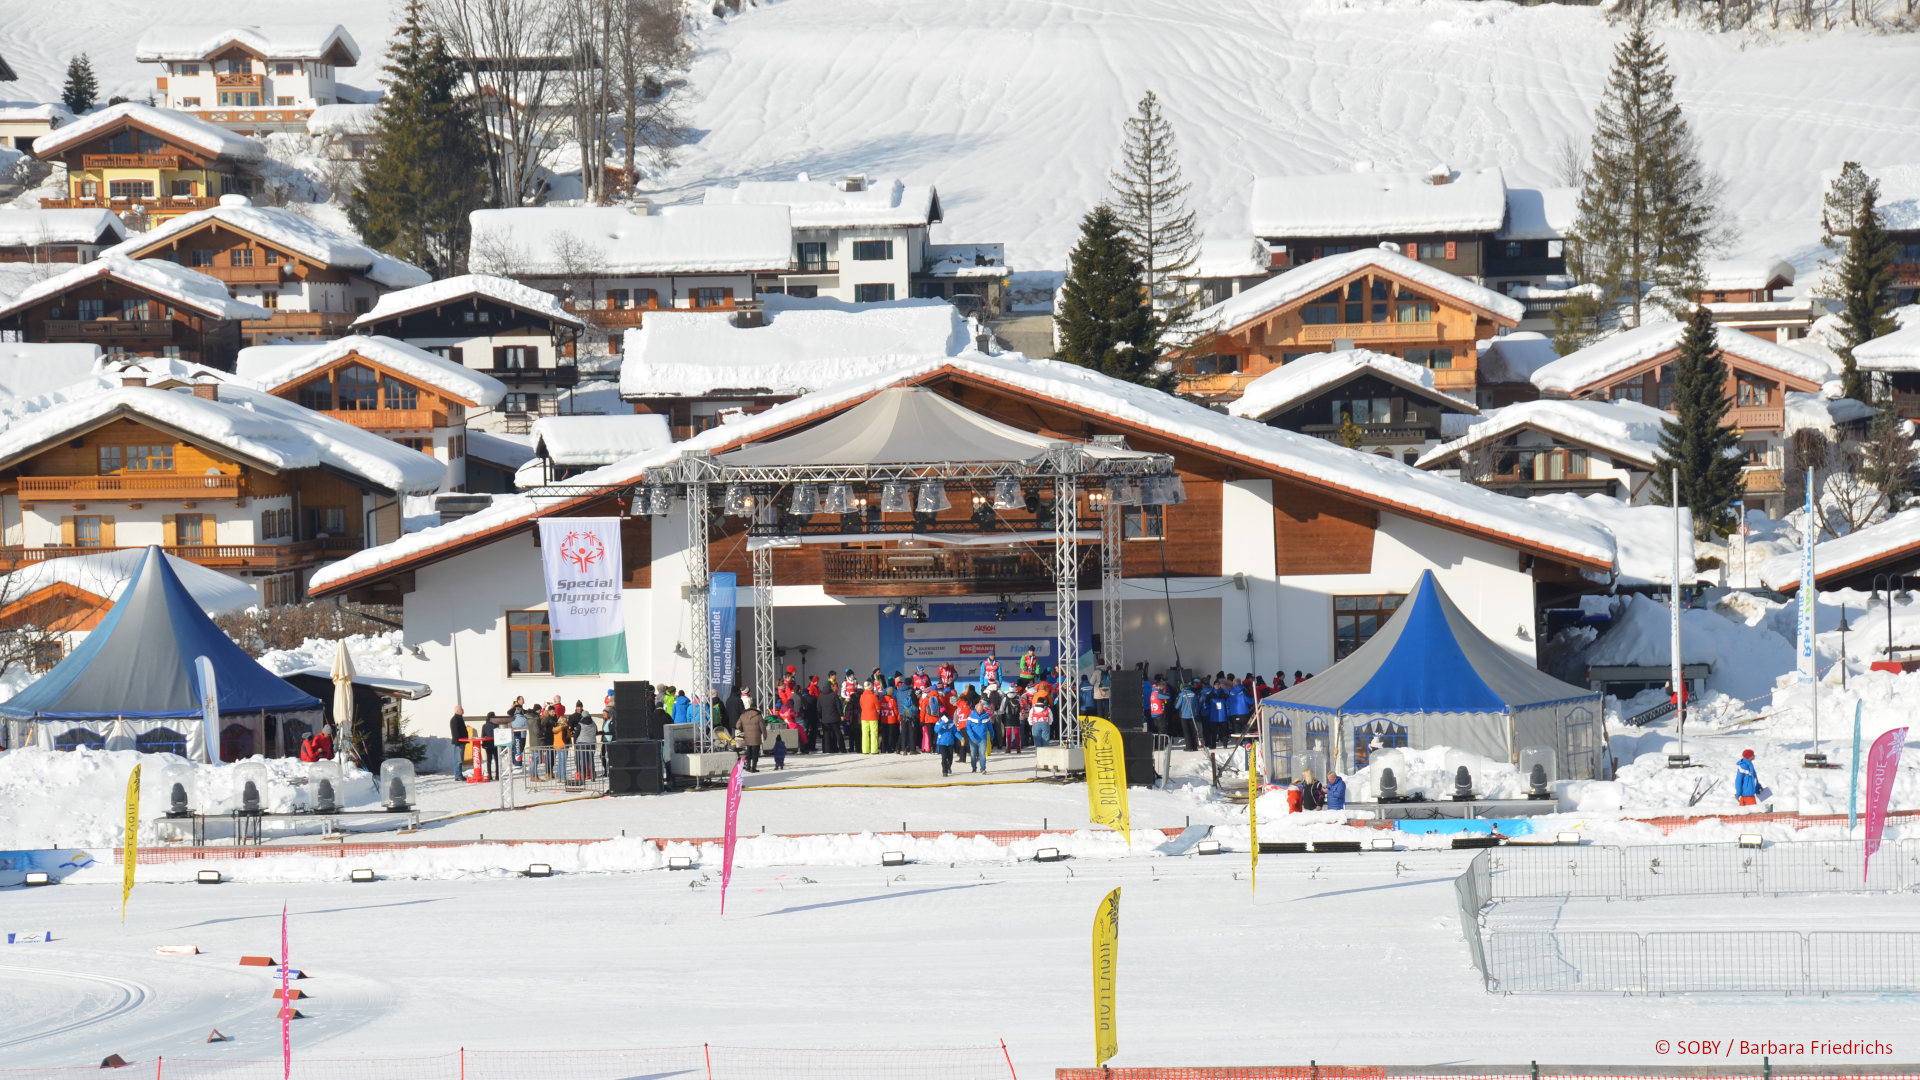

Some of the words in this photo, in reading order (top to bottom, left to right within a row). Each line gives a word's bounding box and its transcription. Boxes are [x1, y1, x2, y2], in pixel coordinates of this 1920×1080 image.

[557, 578, 613, 590] Special
[551, 591, 622, 604] Olympics
[570, 605, 607, 616] Bayern
[711, 611, 721, 653] verbindet
[711, 656, 721, 684] Bauen
[723, 637, 732, 684] Menschen
